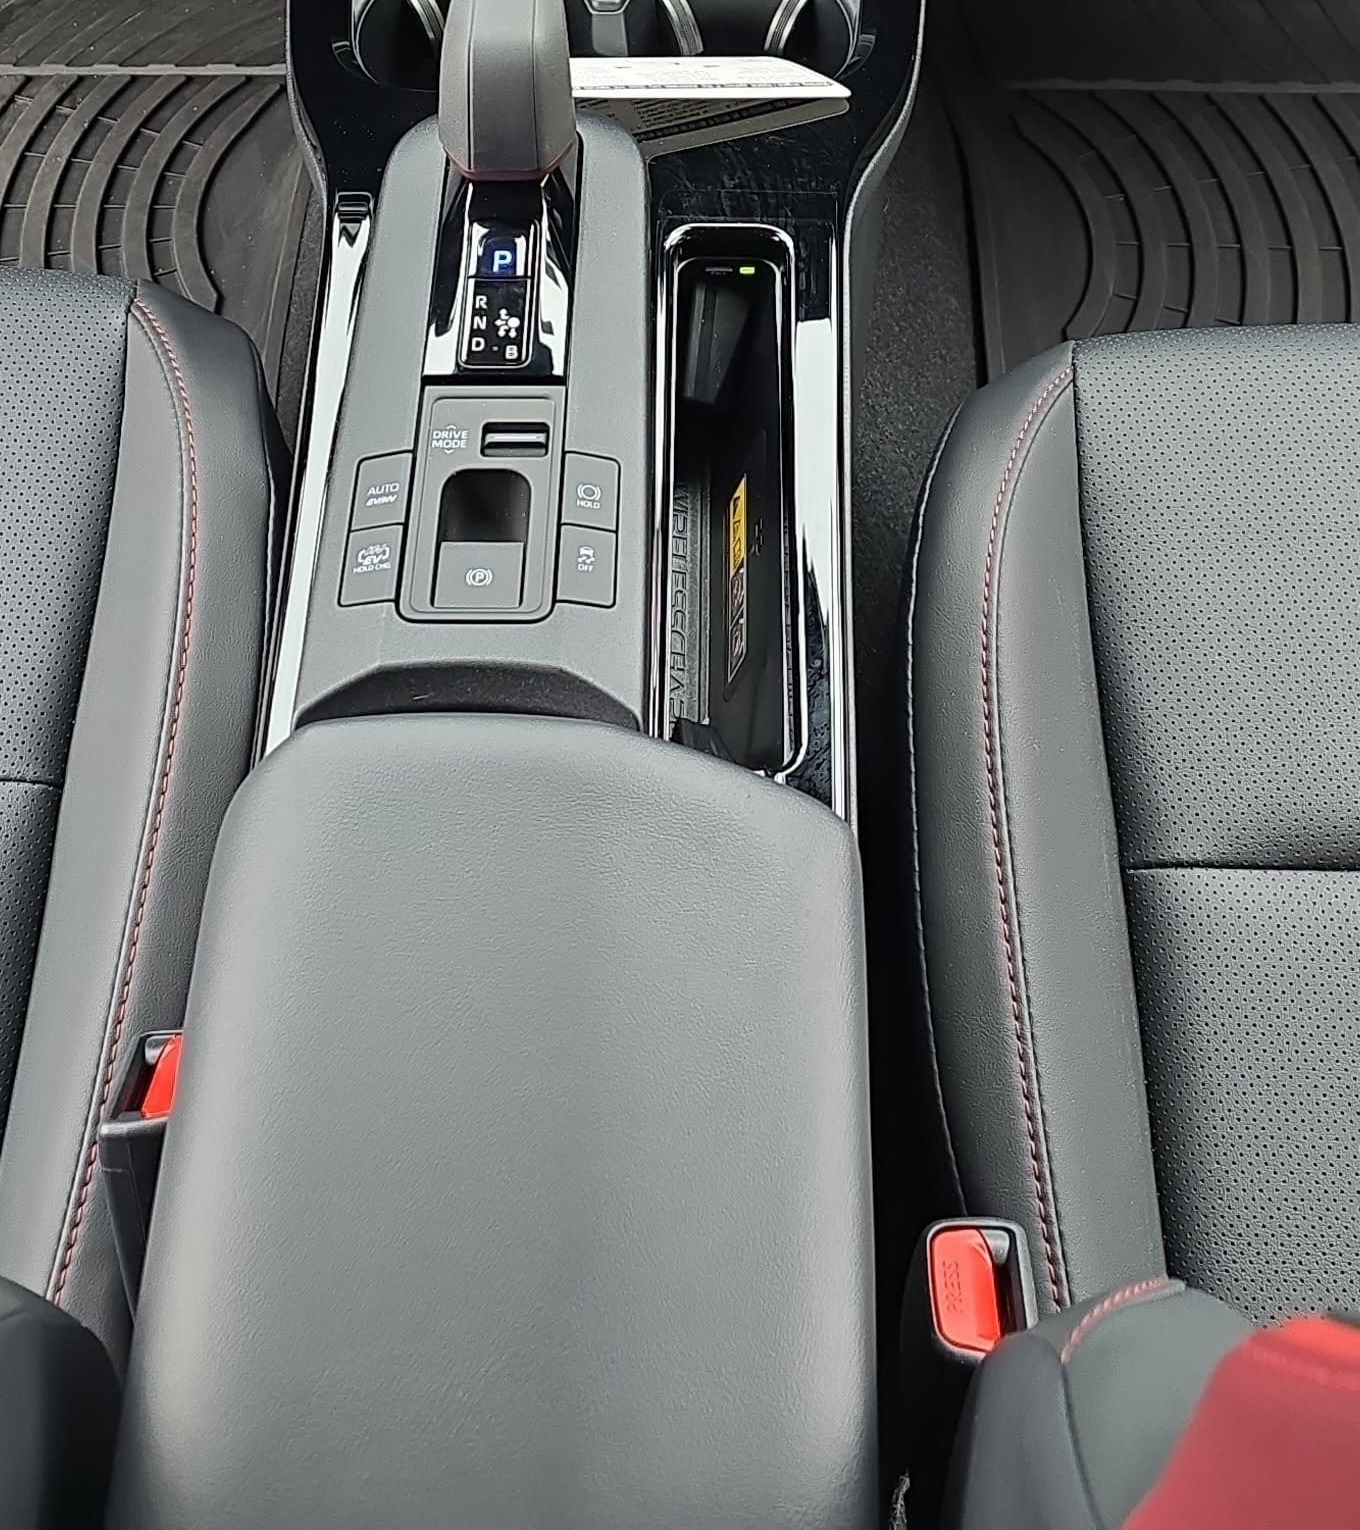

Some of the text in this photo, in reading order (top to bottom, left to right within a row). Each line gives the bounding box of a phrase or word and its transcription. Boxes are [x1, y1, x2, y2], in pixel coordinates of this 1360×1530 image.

[492, 250, 512, 273] P
[475, 295, 488, 309] R
[473, 316, 487, 330] N
[471, 337, 485, 351] D
[505, 345, 519, 359] B
[433, 430, 468, 439] DRIVE
[432, 439, 467, 448] MODE
[367, 483, 400, 496] AUTO
[577, 499, 600, 509] HOLD
[363, 554, 385, 565] EV
[353, 562, 392, 574] HOLD CHG
[578, 564, 593, 572] OFF
